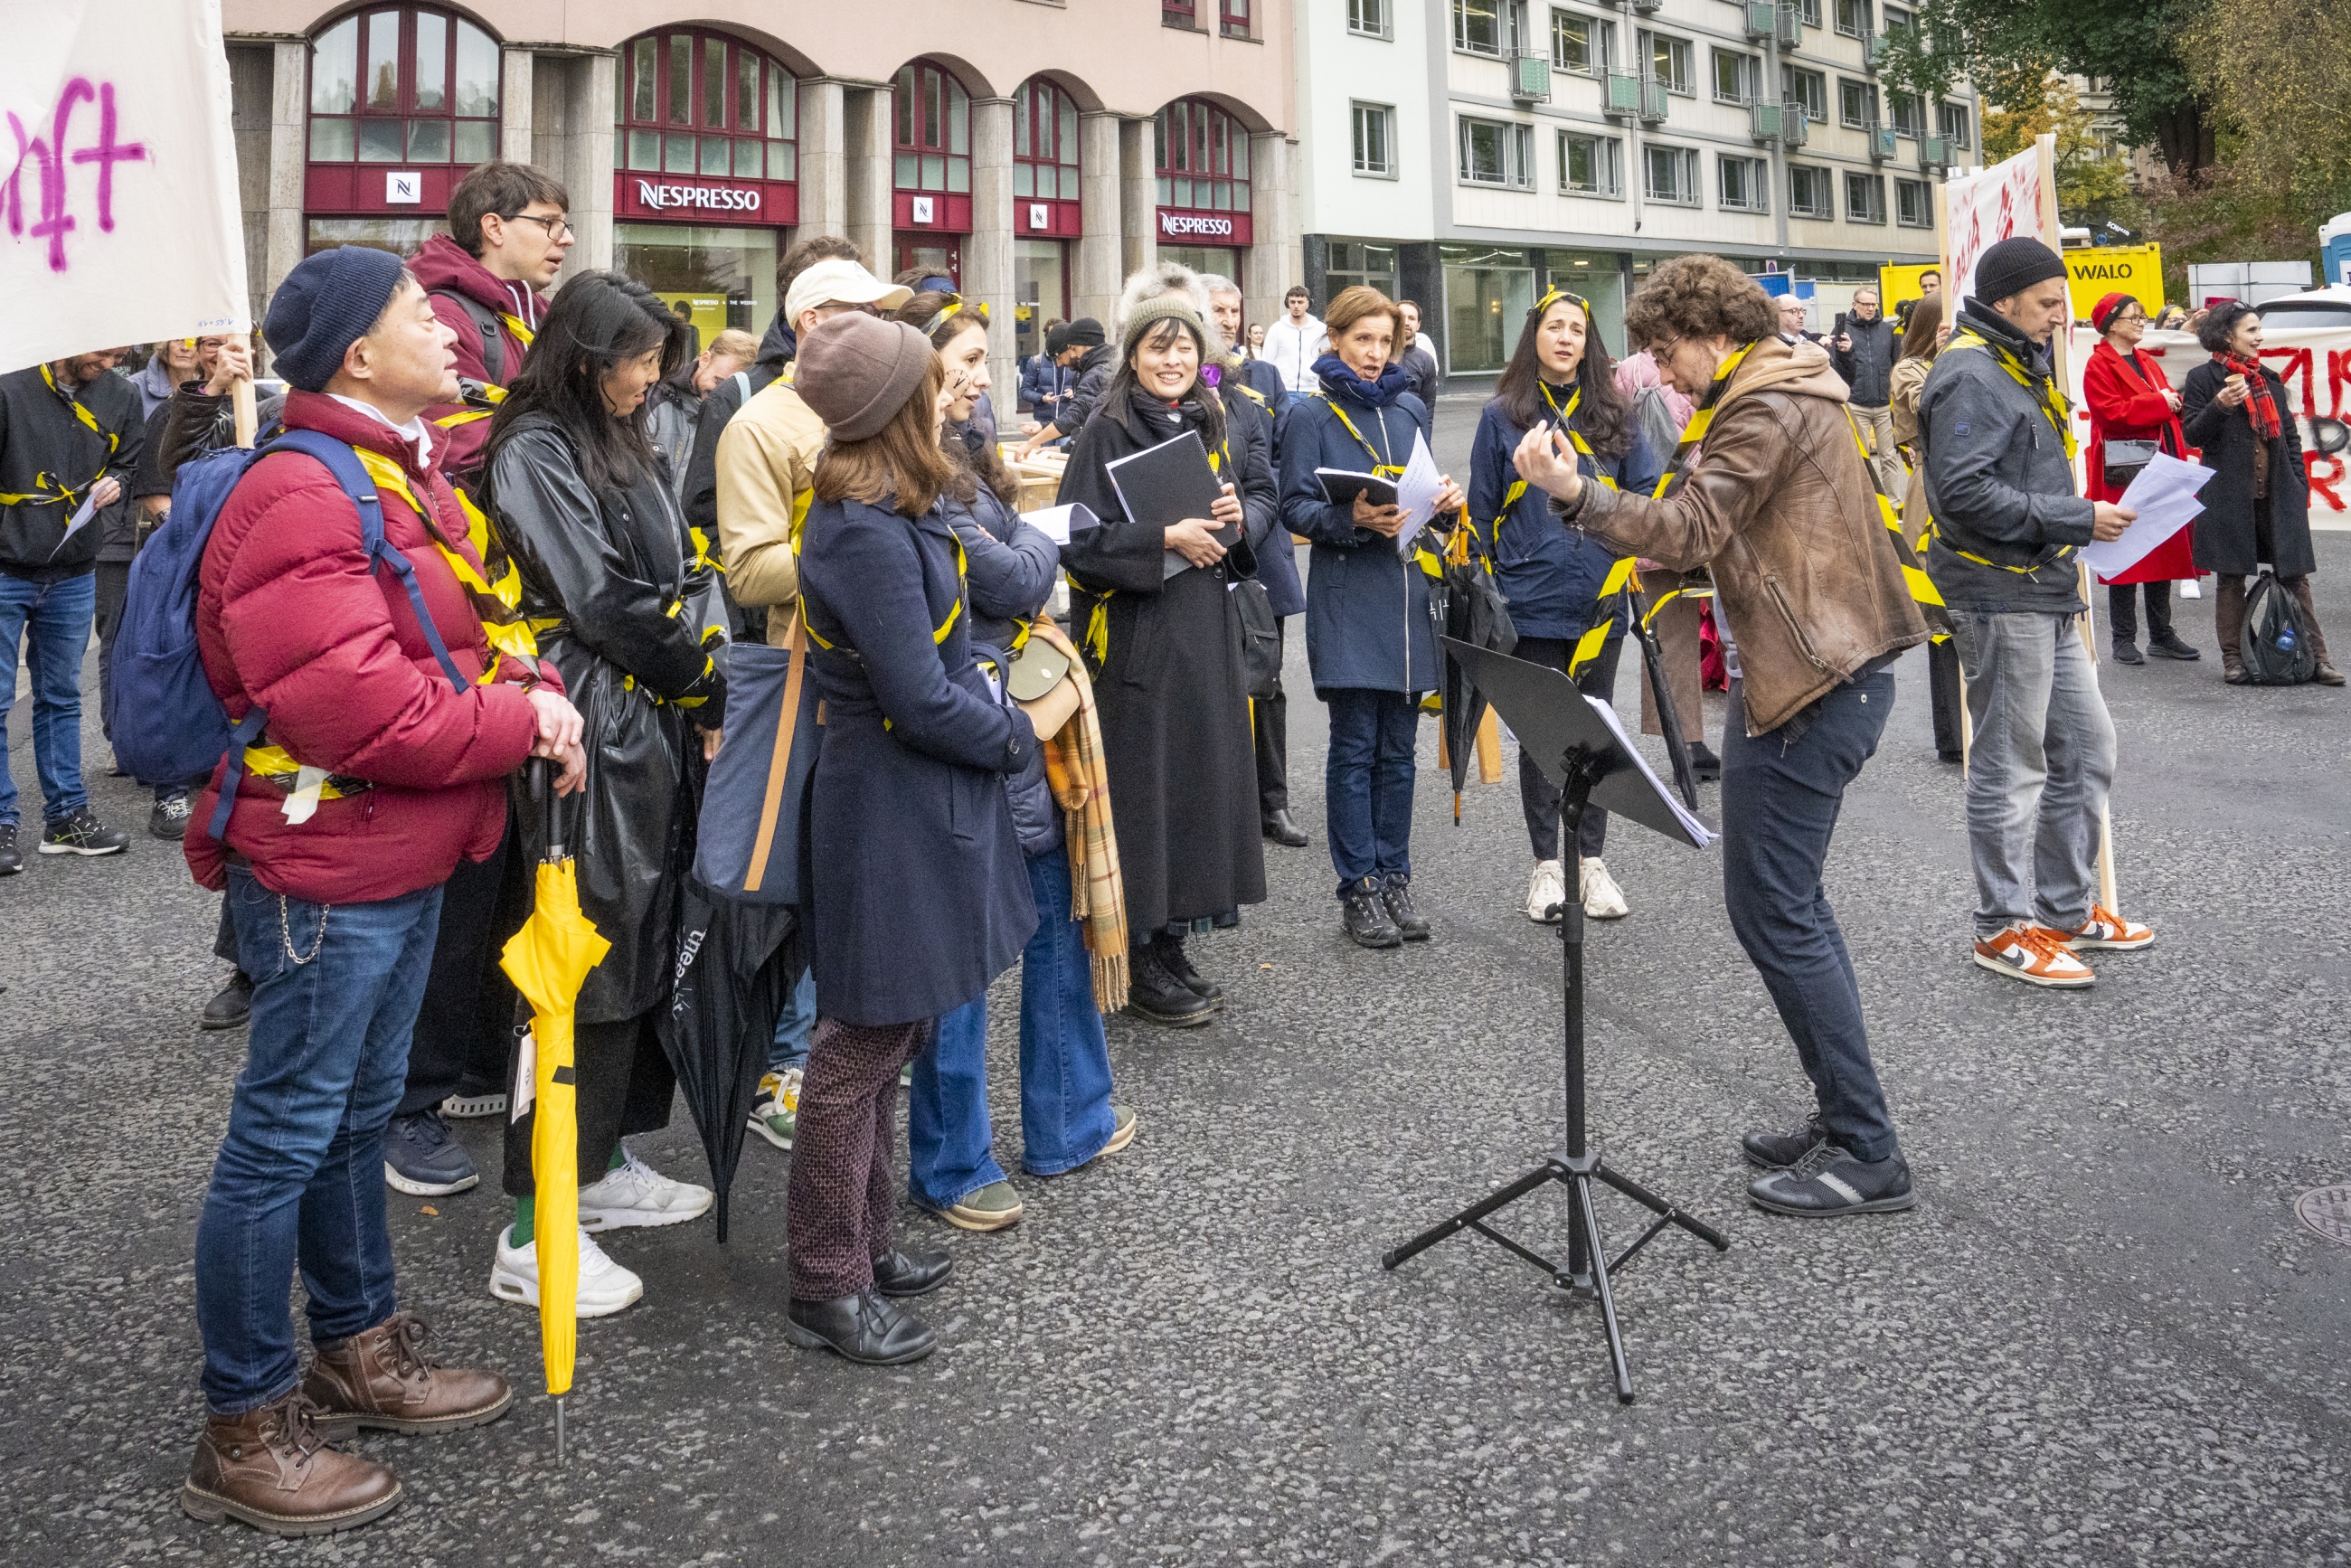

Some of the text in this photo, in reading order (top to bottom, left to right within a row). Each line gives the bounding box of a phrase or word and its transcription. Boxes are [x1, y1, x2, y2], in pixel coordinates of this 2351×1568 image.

[0, 77, 146, 272] nft
[635, 179, 760, 211] NESPRESSO
[1158, 212, 1232, 236] NESPRESSO
[2106, 221, 2130, 237] SCHMID
[2072, 263, 2133, 280] WALO
[692, 298, 719, 307] NESPRESSO
